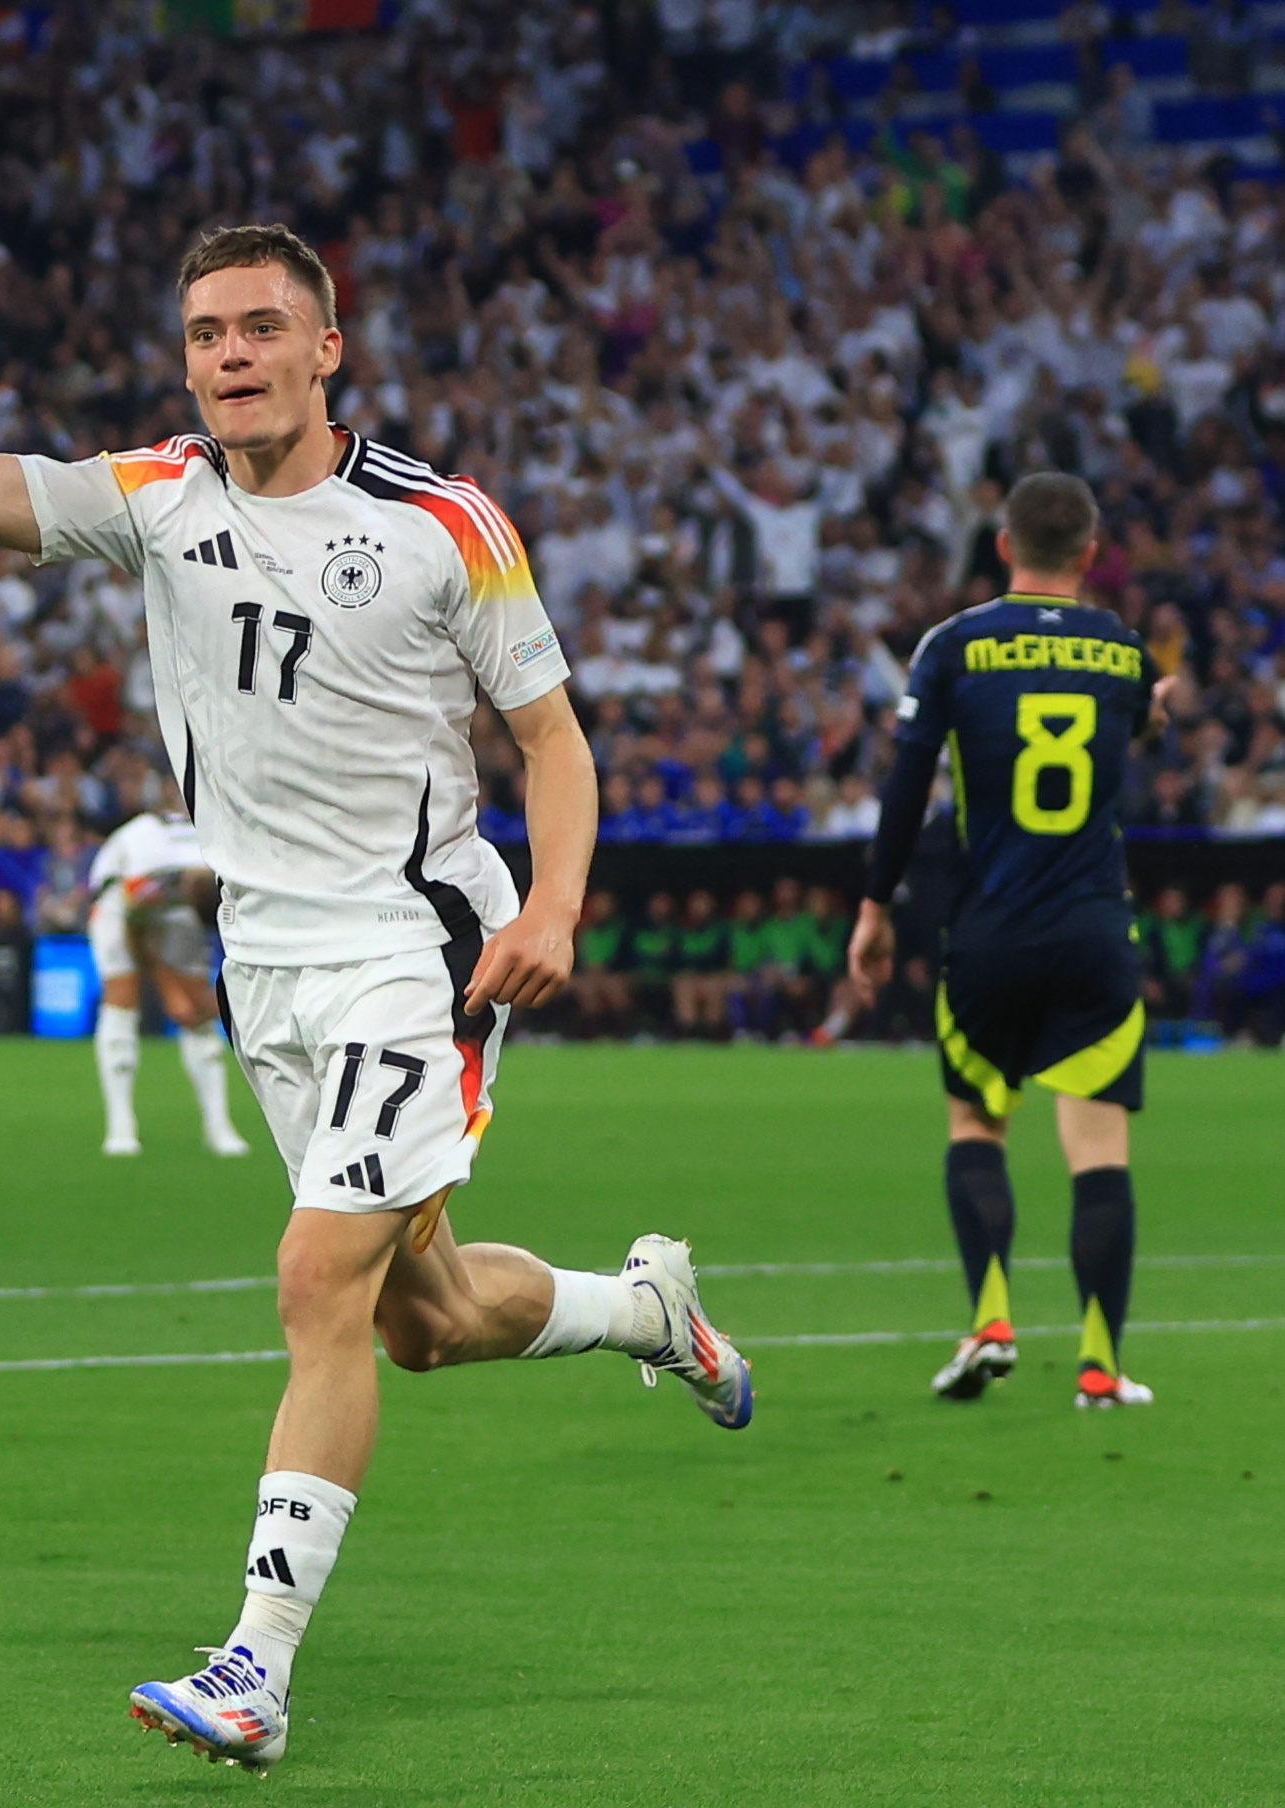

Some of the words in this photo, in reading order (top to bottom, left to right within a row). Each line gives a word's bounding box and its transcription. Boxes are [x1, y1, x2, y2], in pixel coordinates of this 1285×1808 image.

[231, 601, 314, 705] 17
[964, 633, 1143, 682] McGREGOR
[1011, 692, 1098, 837] 8
[330, 1041, 429, 1142] 17
